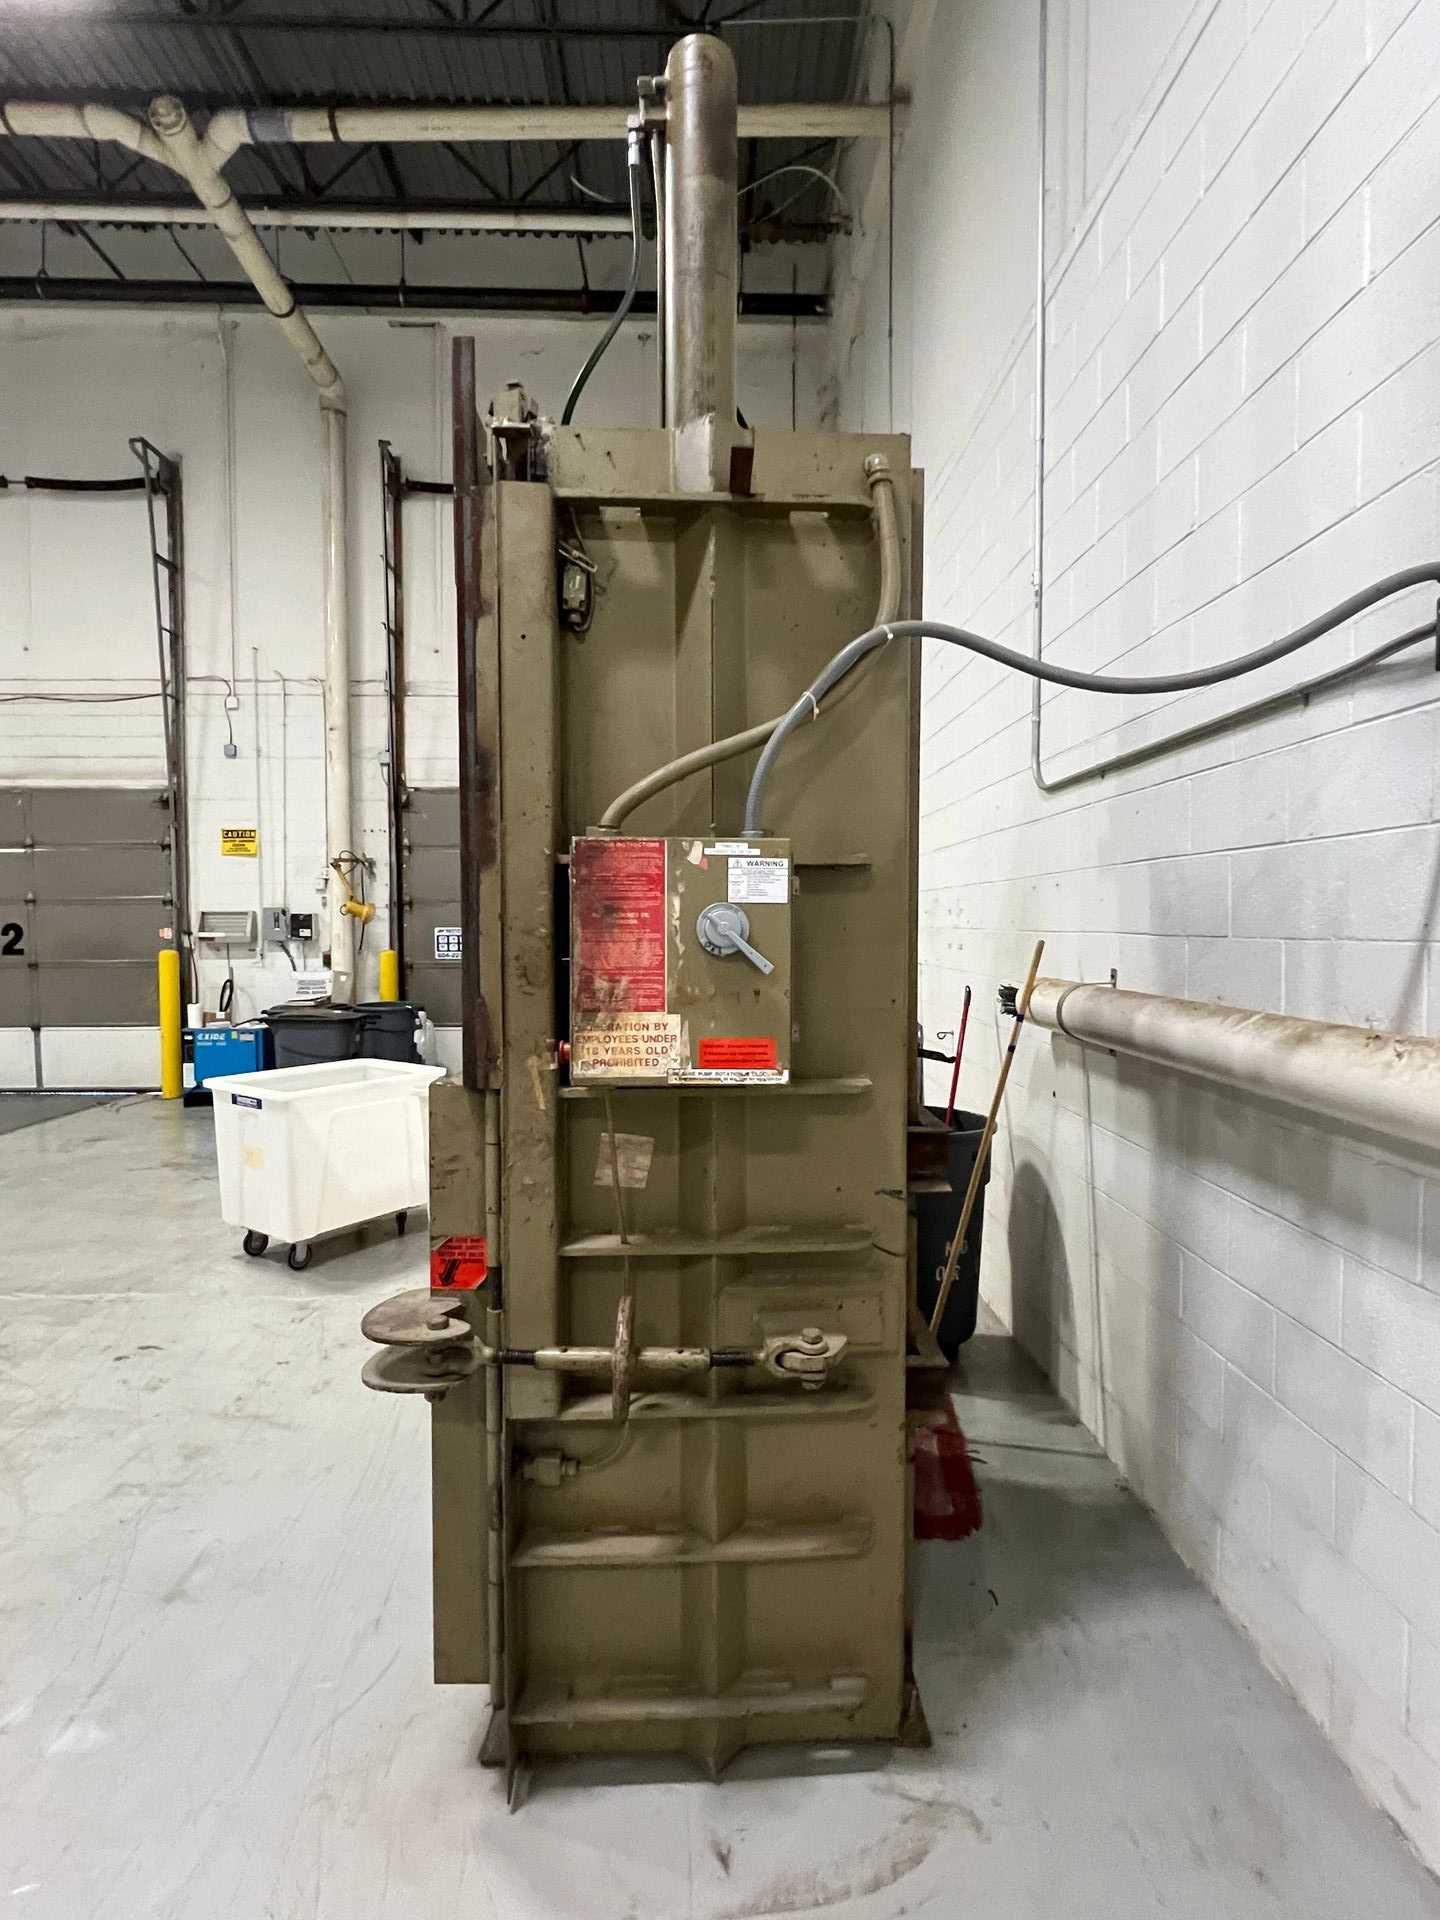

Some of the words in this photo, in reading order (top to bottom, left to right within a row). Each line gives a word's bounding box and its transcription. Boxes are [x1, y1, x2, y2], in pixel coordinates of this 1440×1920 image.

[1, 922, 25, 956] 2
[654, 1022, 669, 1031] BY
[575, 1034, 639, 1044] EMPLOYEES
[641, 1034, 677, 1044] UNDER
[603, 1046, 641, 1056] YEARS
[645, 1045, 669, 1056] OLD
[592, 1058, 660, 1067] PROHIBITED
